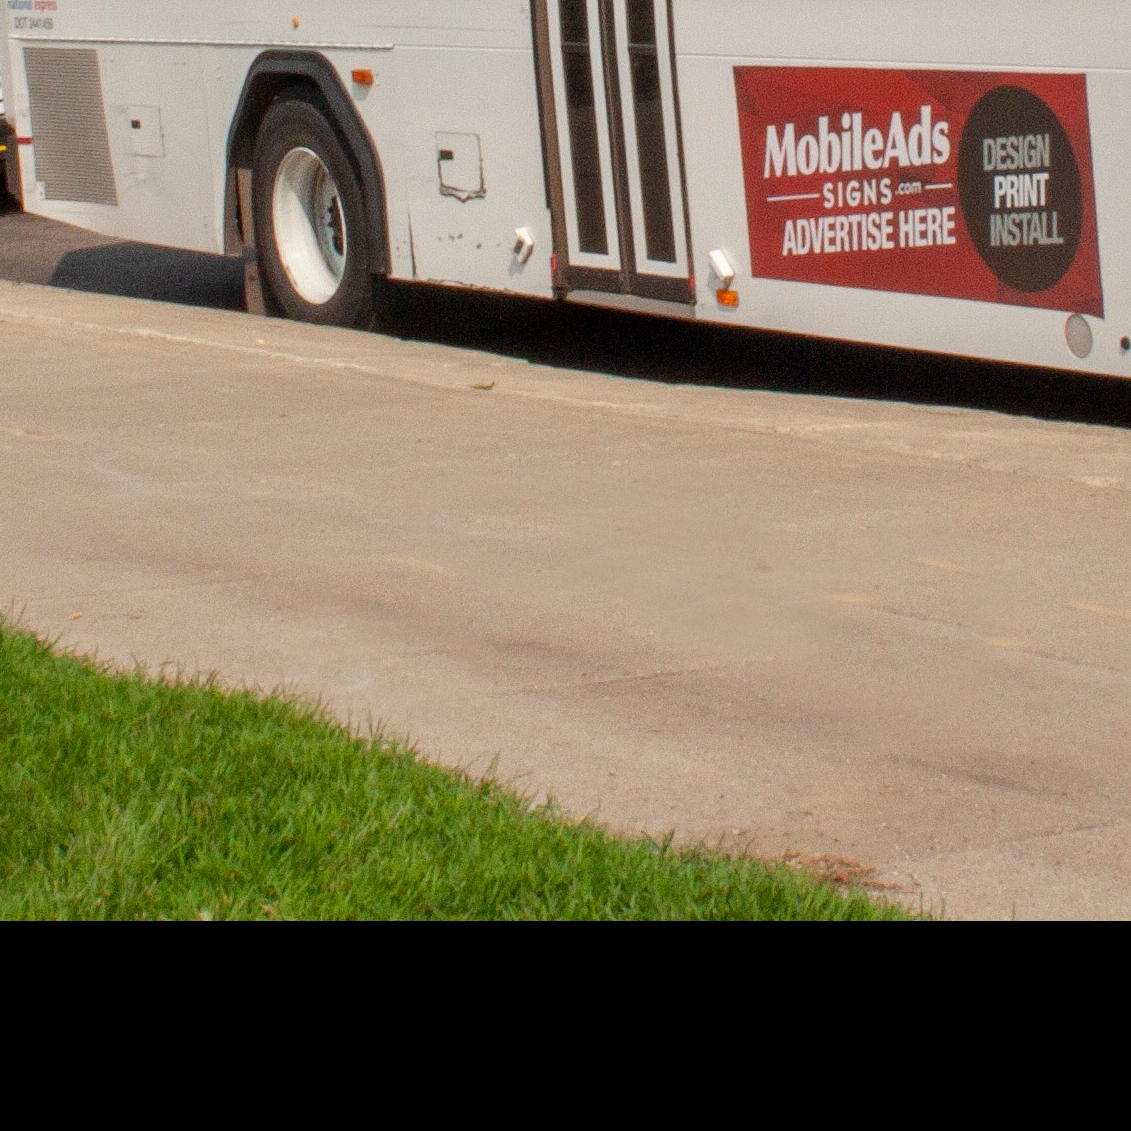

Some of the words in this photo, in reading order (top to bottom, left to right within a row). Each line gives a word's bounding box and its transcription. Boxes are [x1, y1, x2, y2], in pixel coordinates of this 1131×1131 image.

[763, 105, 951, 179] MobileAds
[983, 133, 1051, 171] DESIGN
[994, 172, 1049, 209] PRINT
[782, 211, 894, 257] ADVERTISE
[899, 206, 957, 245] HERE
[990, 211, 1065, 247] INSTALL
